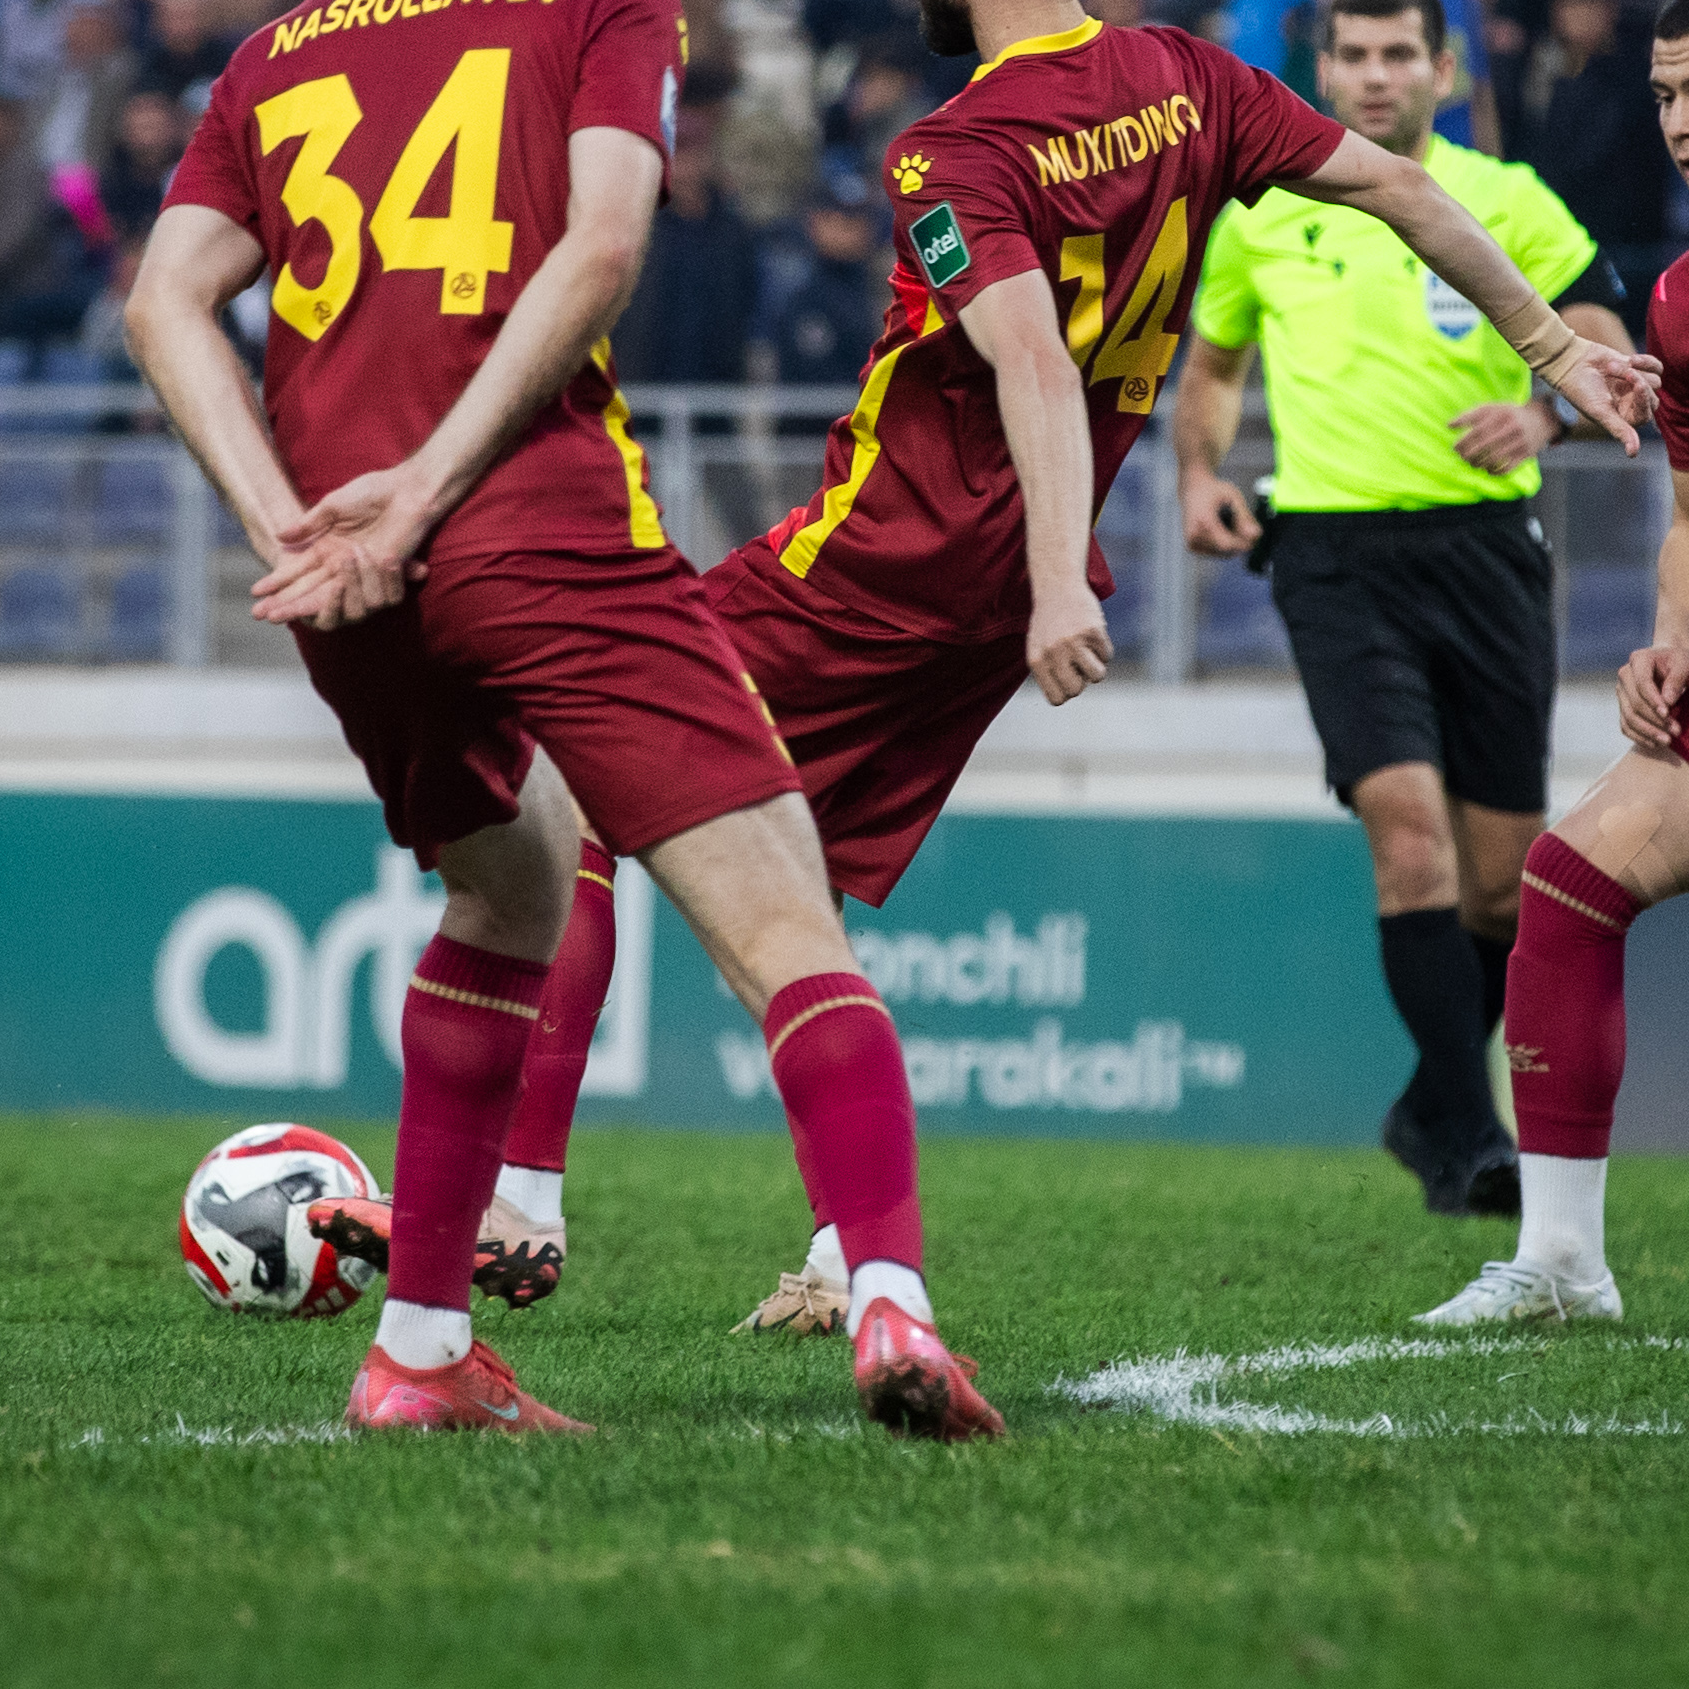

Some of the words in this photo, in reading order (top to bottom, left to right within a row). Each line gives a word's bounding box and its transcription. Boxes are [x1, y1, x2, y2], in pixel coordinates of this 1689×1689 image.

[254, 47, 515, 343] 34
[1059, 196, 1188, 415] 14
[153, 839, 657, 1097] artl
